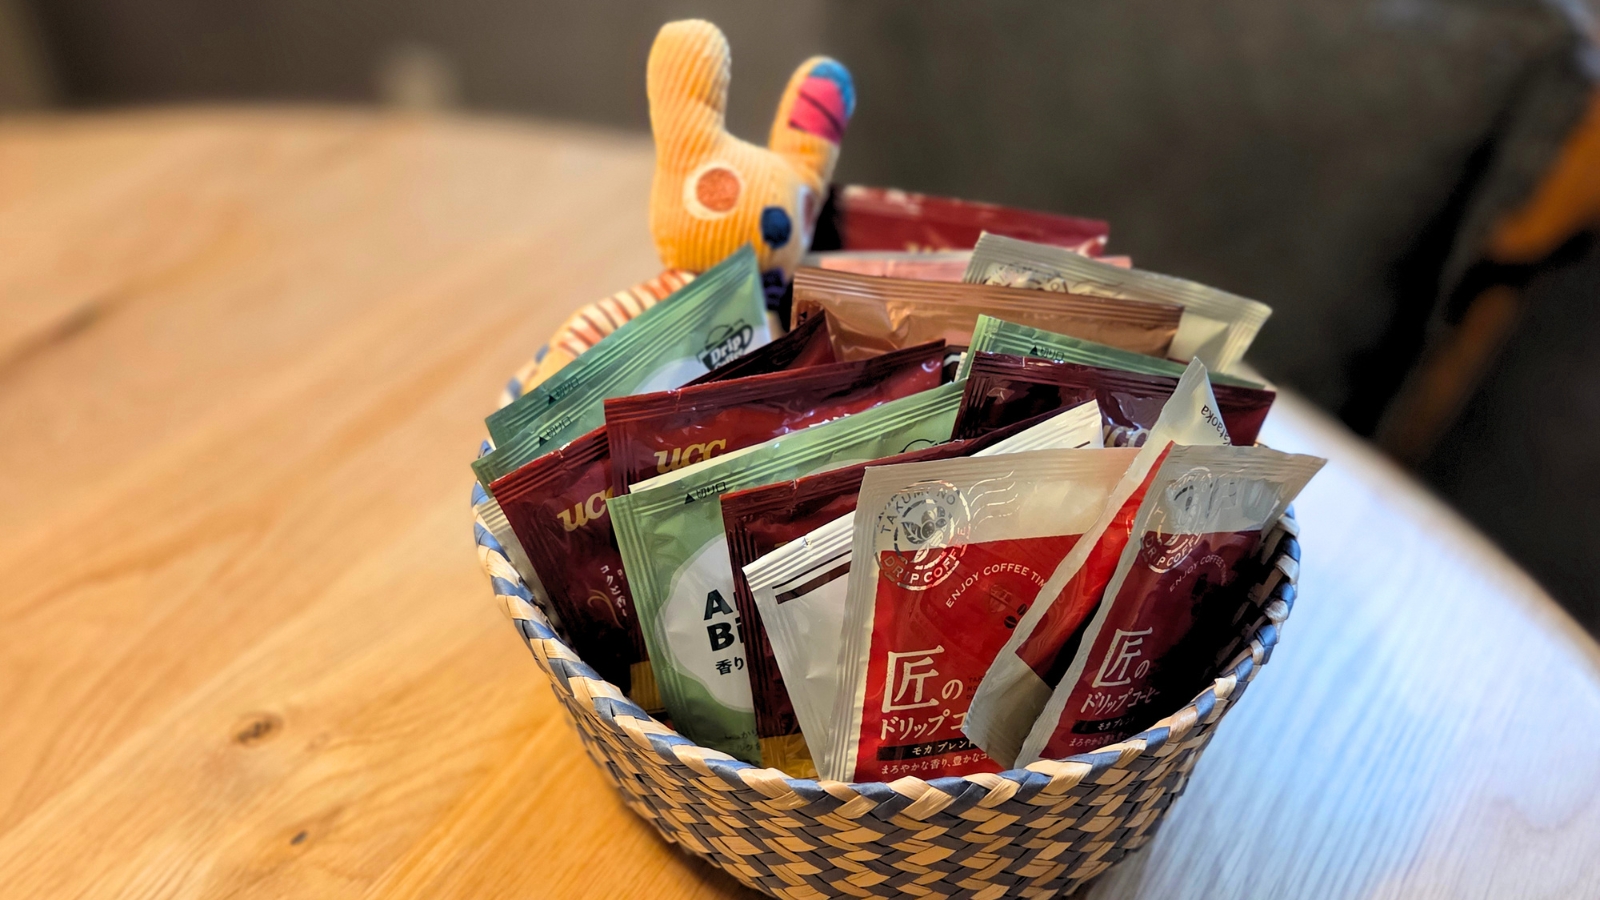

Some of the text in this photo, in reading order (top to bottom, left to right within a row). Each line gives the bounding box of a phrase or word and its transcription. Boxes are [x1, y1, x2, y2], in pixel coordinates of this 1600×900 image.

[710, 335, 742, 366] Drip
[696, 481, 727, 499] 切り口
[884, 555, 920, 584] DRIP
[1169, 561, 1199, 592] ENJOY
[945, 572, 980, 608] ENJOY
[983, 563, 1030, 577] COFFEE
[1092, 627, 1153, 688] 匠の
[881, 645, 964, 714] 匠の
[1080, 687, 1160, 715] ドリップコーヒー
